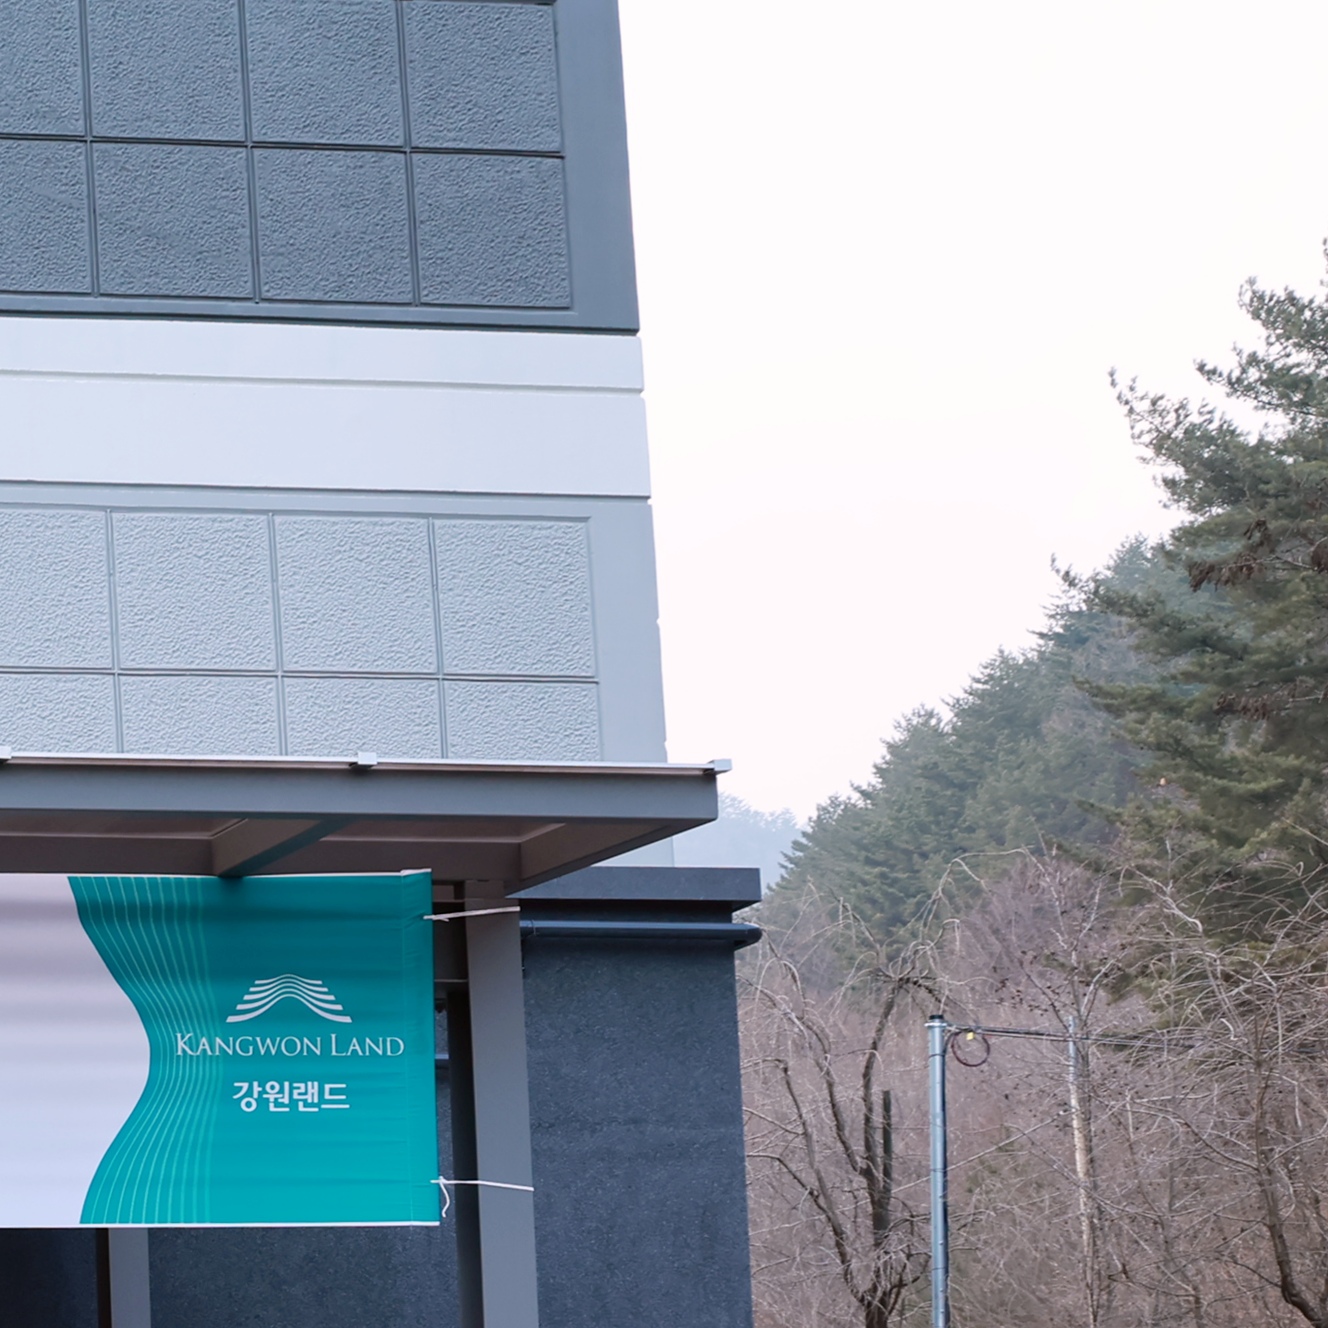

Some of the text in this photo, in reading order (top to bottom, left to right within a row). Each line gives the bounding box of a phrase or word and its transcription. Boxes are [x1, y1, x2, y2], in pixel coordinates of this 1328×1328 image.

[177, 1033, 404, 1056] KANGWON LAND
[233, 1081, 350, 1112] 강원랜드
